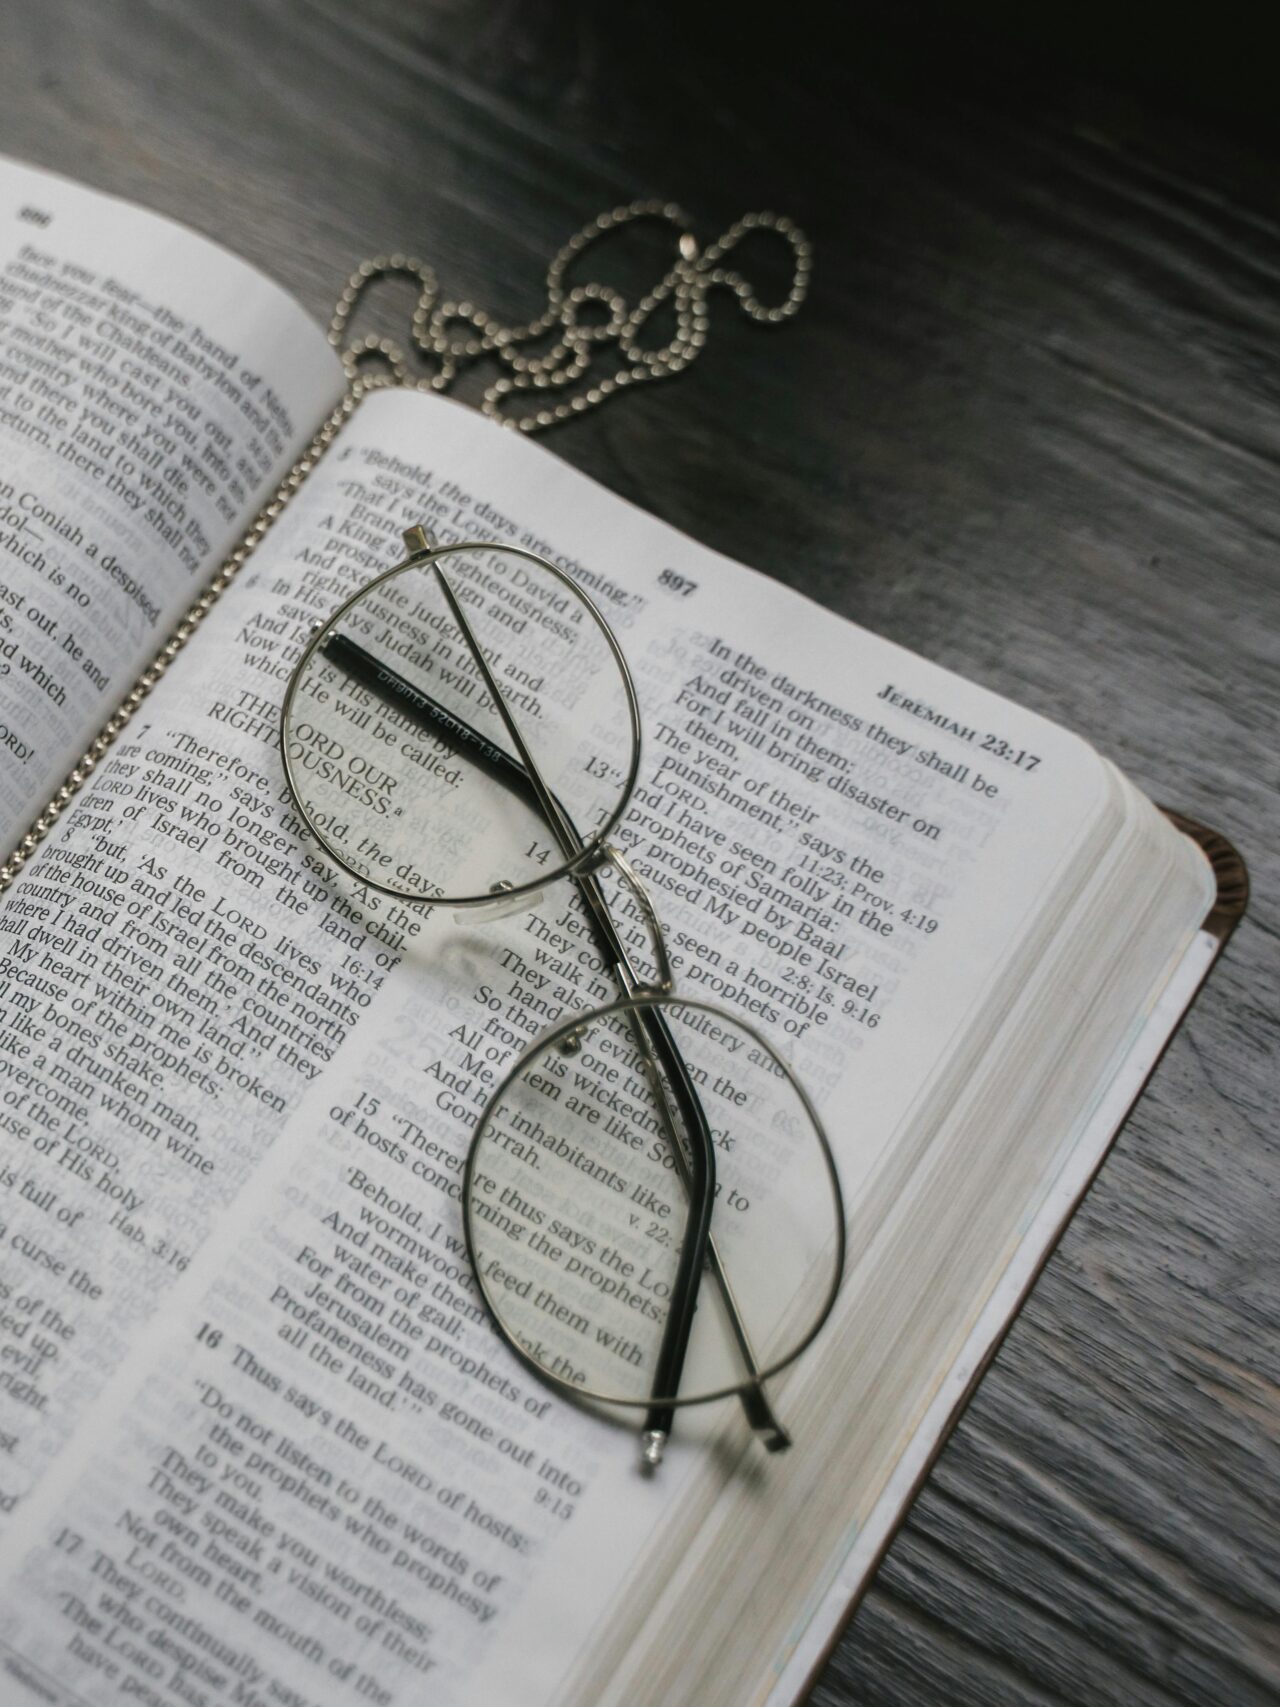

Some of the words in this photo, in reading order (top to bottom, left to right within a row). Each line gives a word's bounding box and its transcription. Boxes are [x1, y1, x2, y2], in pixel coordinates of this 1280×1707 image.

[55, 439, 106, 480] there
[104, 471, 147, 511] they
[143, 507, 184, 549] shall
[177, 544, 200, 575] not
[657, 568, 698, 596] 897
[60, 632, 84, 661] he
[81, 658, 110, 692] and
[334, 699, 372, 730] will
[371, 720, 397, 746] be
[400, 743, 463, 788] called:
[707, 637, 732, 661] In
[733, 652, 768, 680] the
[770, 675, 863, 731] darkness
[865, 723, 914, 756] they
[914, 750, 970, 784] shall
[970, 773, 998, 798] be
[876, 684, 976, 742] JEREMIAH
[978, 733, 1041, 771] 23:17
[524, 840, 551, 865] 14
[797, 854, 848, 891] 11:23;
[849, 881, 894, 915] Prov.
[899, 908, 938, 934] 4:19
[339, 954, 385, 991] 16:14
[815, 984, 835, 1007] Is.
[840, 998, 881, 1028] 9:16
[5, 938, 39, 963] My
[37, 950, 91, 989] heart
[94, 981, 156, 1029] within
[157, 1023, 191, 1050] me
[191, 1045, 213, 1064] is
[214, 1054, 286, 1113] broken
[31, 1053, 47, 1070] a
[47, 1063, 95, 1100] man
[99, 1093, 161, 1142] whom
[166, 1135, 214, 1175] wine
[18, 1178, 57, 1212] full
[56, 1207, 84, 1228] of
[194, 1321, 224, 1349] 16
[231, 1343, 282, 1393] Thus
[282, 1386, 333, 1427] says
[333, 1417, 370, 1451] the
[371, 1441, 433, 1491] LORD
[436, 1487, 466, 1510] of
[268, 1284, 396, 1379] Profaneness
[397, 1369, 438, 1406] has
[437, 1401, 494, 1442] gone
[496, 1437, 535, 1468] out
[537, 1458, 582, 1496] into
[146, 1466, 200, 1516] They
[200, 1510, 264, 1563] speak
[265, 1556, 283, 1575] a
[286, 1567, 352, 1621] vision
[354, 1615, 386, 1638] of
[381, 1629, 436, 1673] their
